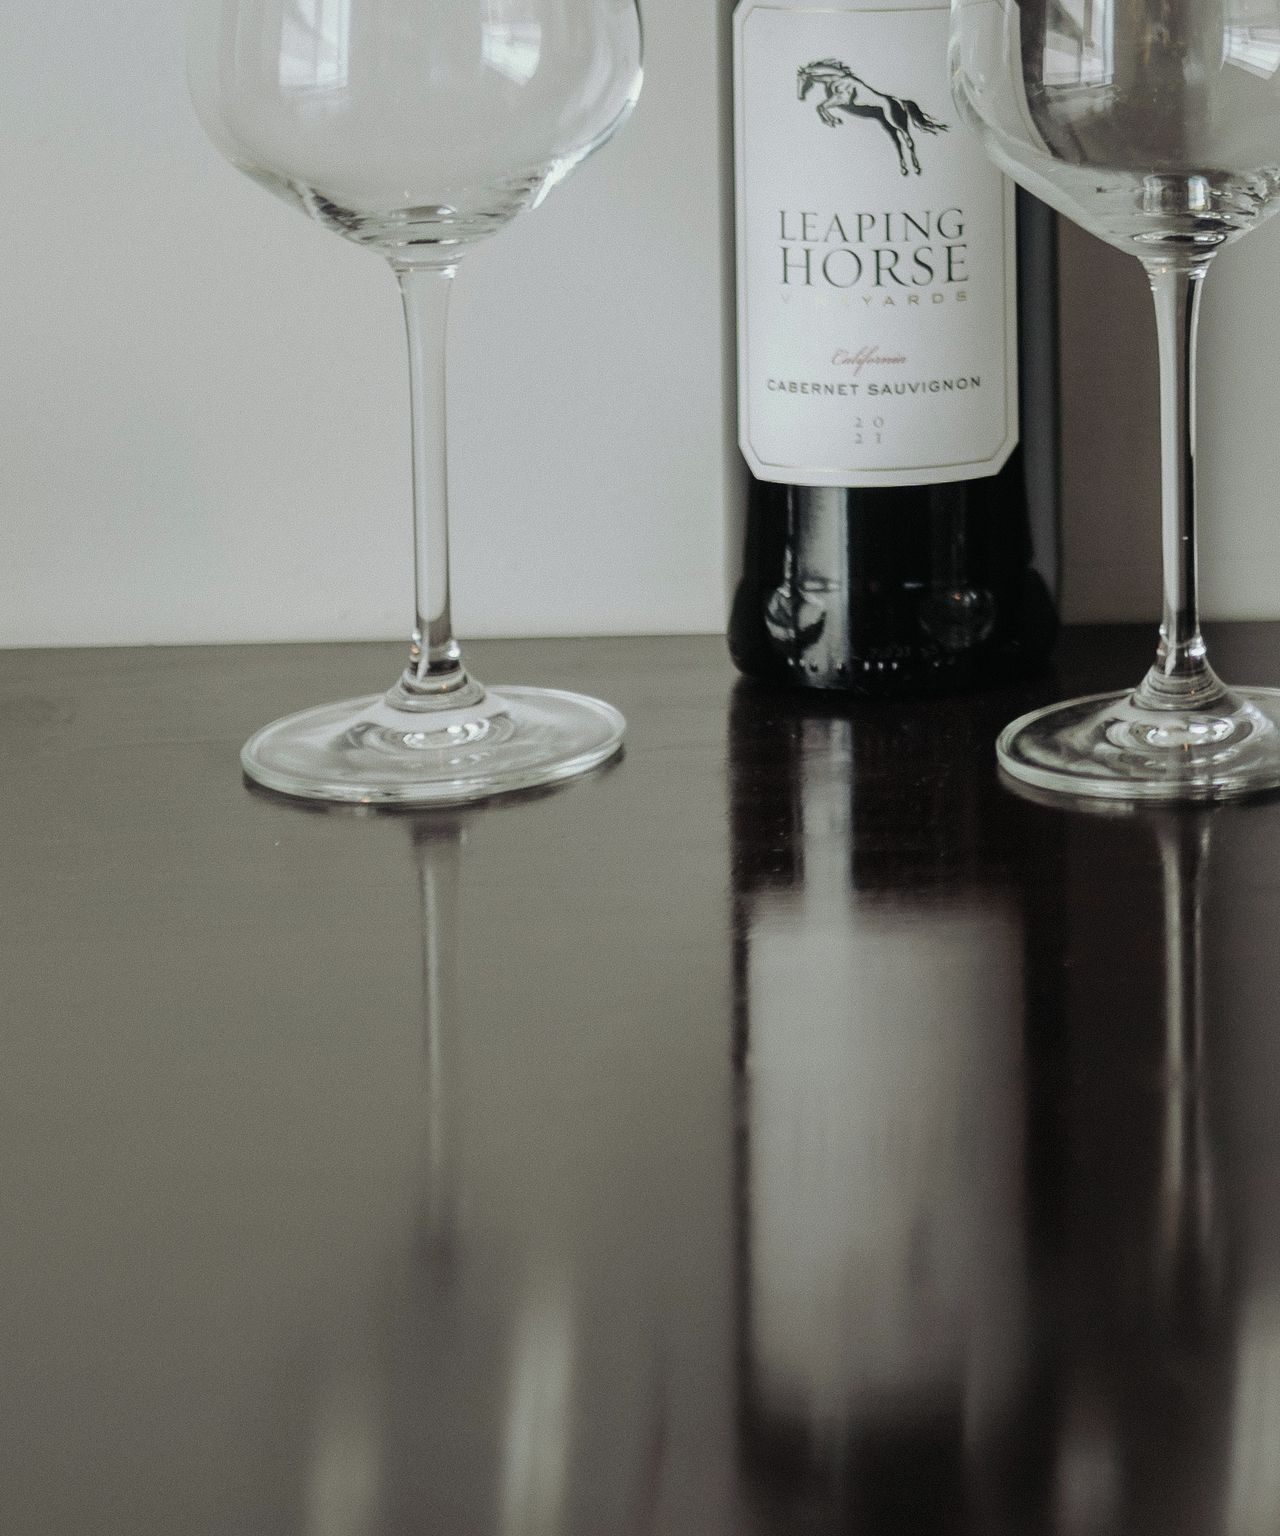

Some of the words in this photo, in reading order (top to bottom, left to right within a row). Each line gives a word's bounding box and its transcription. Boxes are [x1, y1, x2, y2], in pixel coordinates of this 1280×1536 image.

[779, 208, 966, 243] LEAPING
[780, 244, 969, 289] HORSE
[780, 291, 968, 306] VYARDS
[832, 345, 907, 376] California
[766, 379, 859, 396] CABERNET
[867, 375, 982, 397] SAUVIGNON
